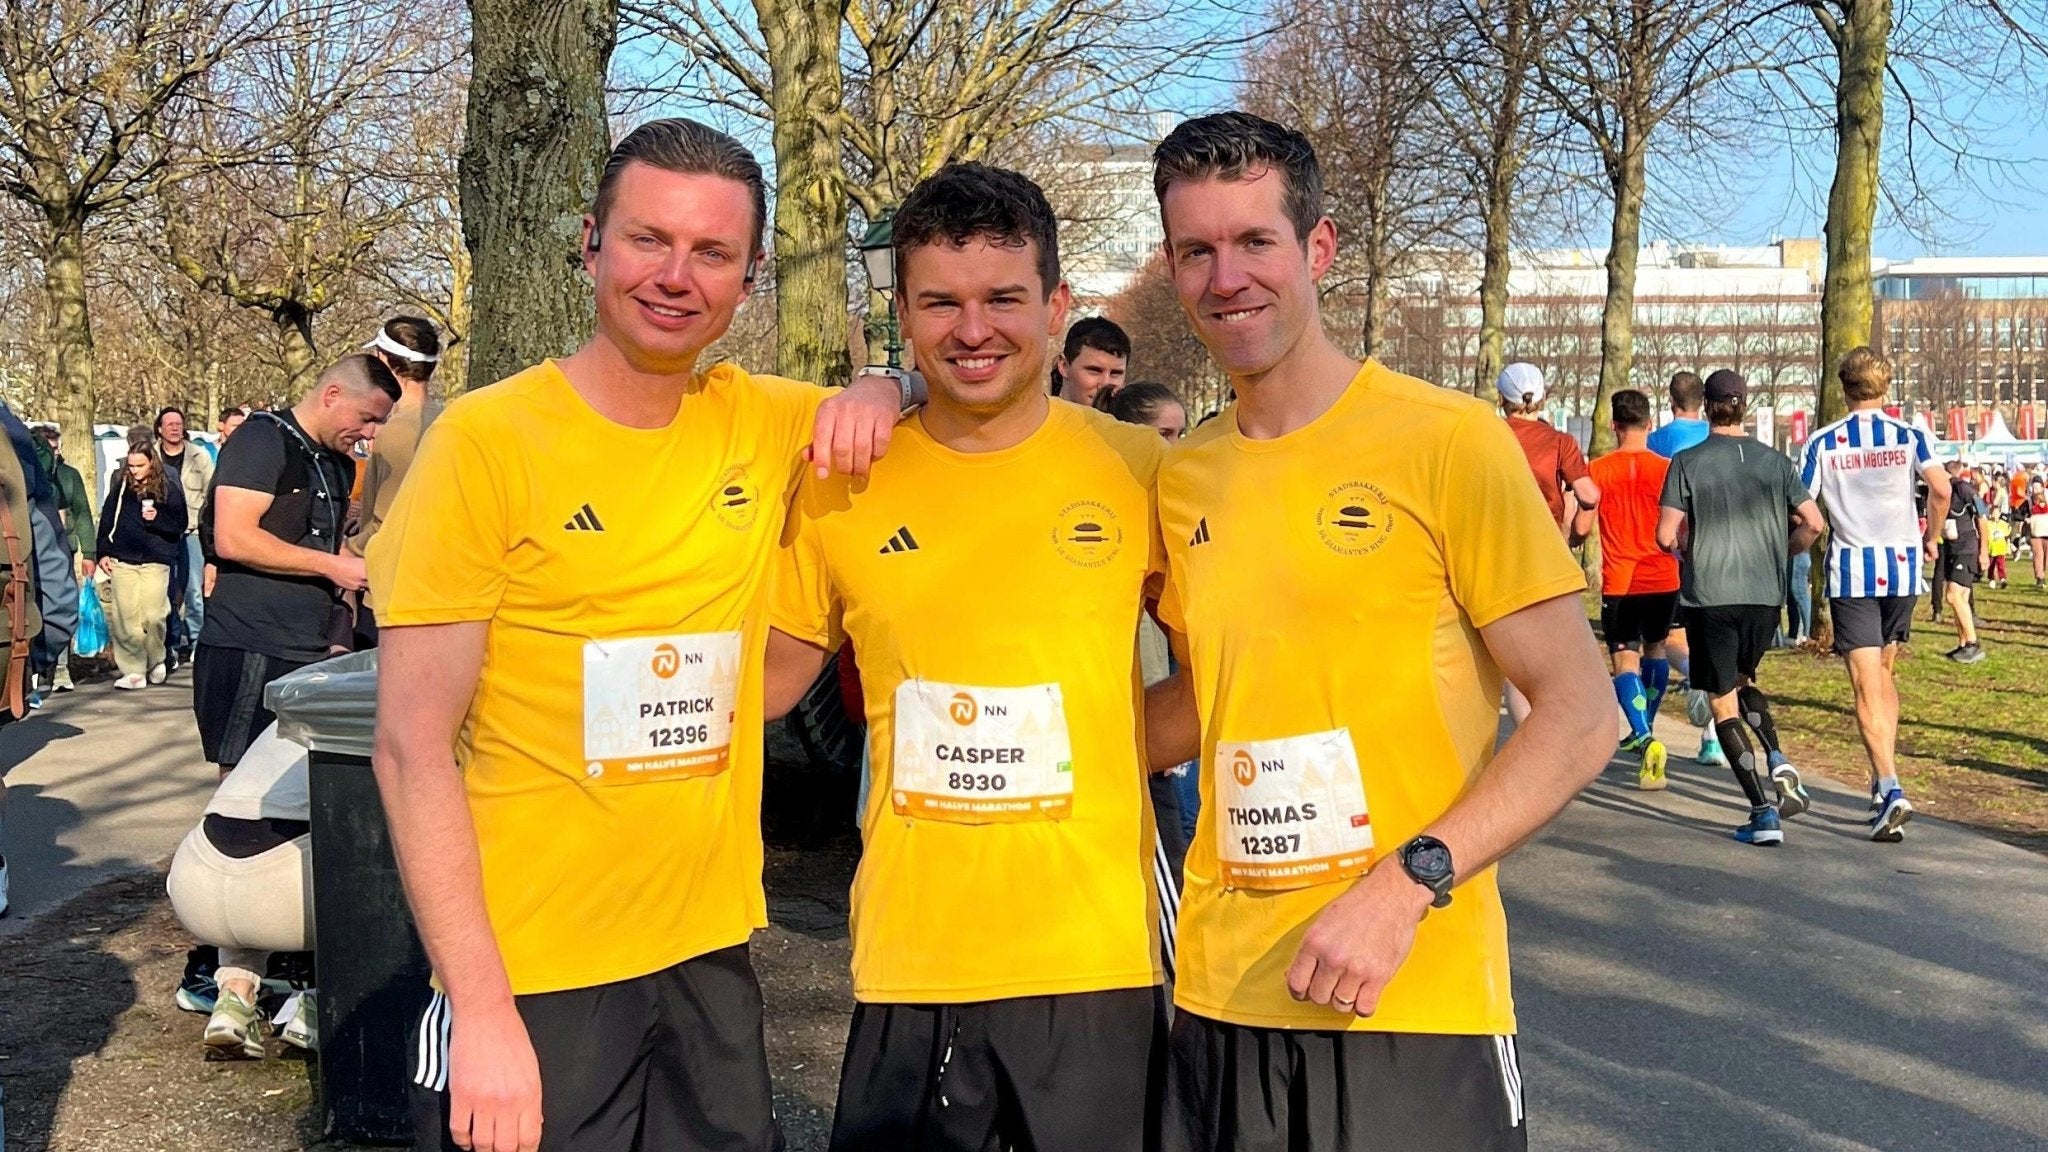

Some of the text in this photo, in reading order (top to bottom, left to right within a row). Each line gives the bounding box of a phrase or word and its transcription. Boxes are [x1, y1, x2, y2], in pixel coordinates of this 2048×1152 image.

[1863, 450, 1906, 468] MBOEPES
[685, 653, 703, 664] NN
[640, 697, 714, 718] PATRICK
[984, 705, 1007, 716] NN
[649, 724, 708, 747] 12396
[936, 744, 1025, 763] CASPER
[1261, 759, 1285, 773] NN
[949, 772, 1006, 791] 8930
[971, 801, 1031, 813] MARATHON
[1228, 803, 1317, 826] THOMAS
[1241, 834, 1301, 855] 12387
[1268, 862, 1330, 877] MARATHON
